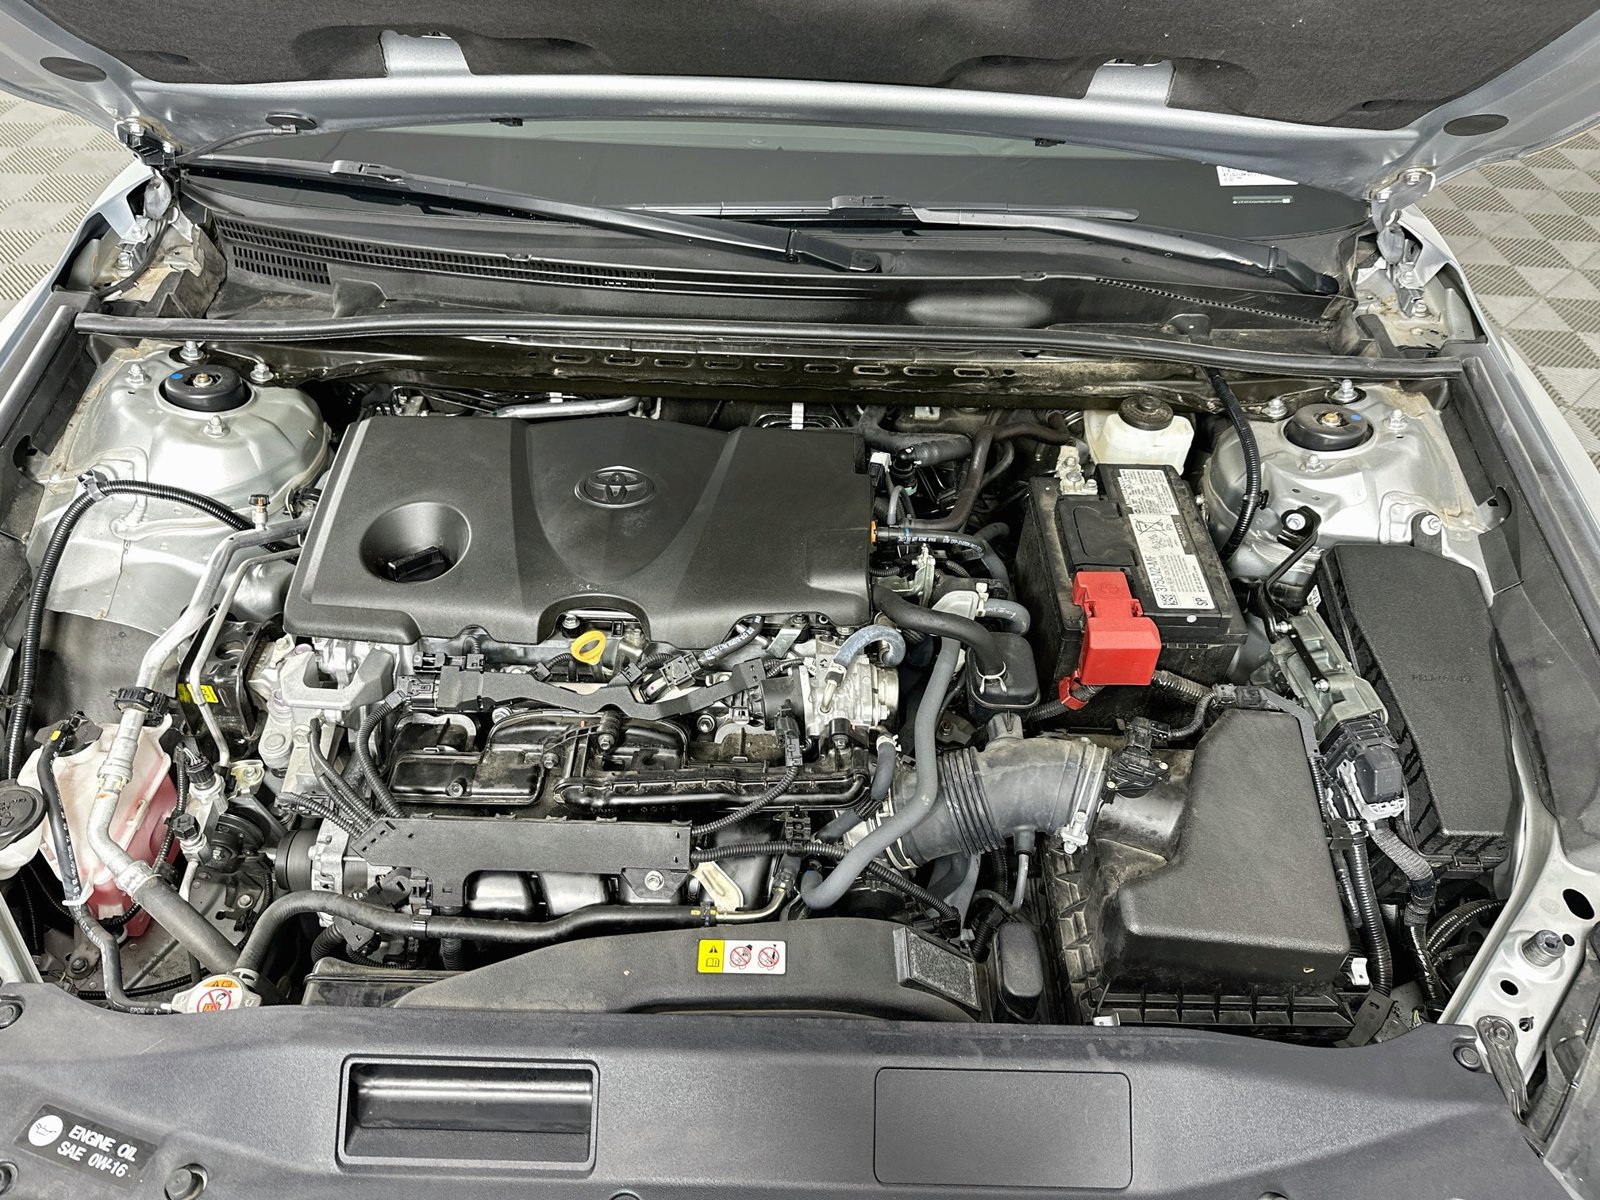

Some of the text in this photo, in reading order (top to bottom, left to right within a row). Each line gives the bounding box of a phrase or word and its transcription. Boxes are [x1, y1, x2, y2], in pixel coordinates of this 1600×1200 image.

[57, 1141, 129, 1178] SAE 0W-16
[68, 1124, 139, 1162] ENGINE OIL
